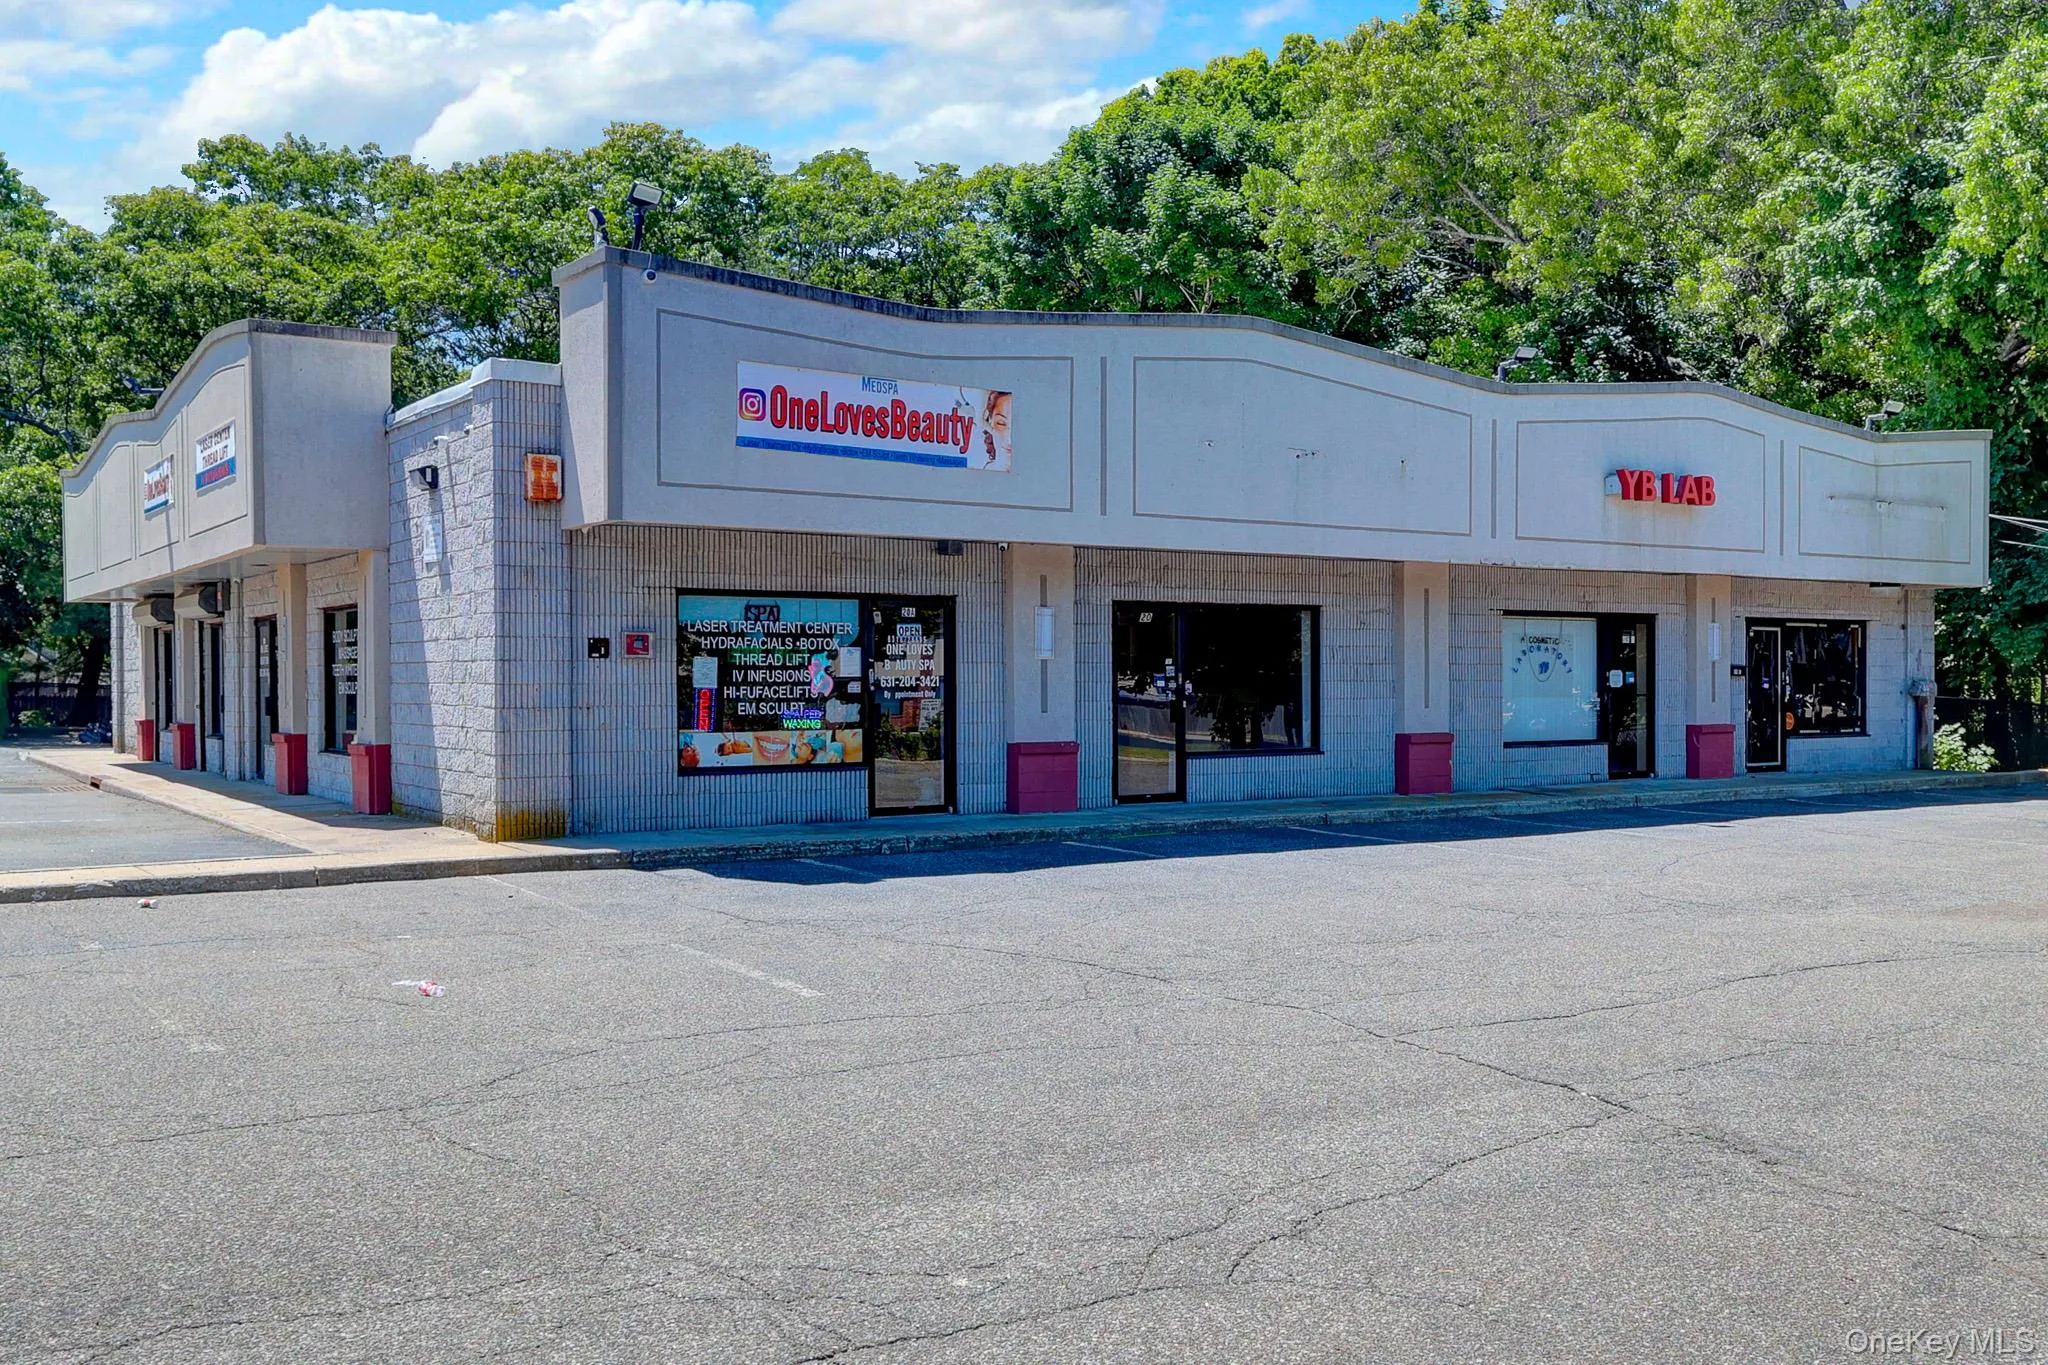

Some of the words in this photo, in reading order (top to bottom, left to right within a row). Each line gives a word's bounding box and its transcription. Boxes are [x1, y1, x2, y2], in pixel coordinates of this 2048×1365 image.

[862, 376, 899, 396] MEDSPA
[770, 384, 975, 454] OneLovesBeauty
[1616, 469, 1657, 501] YB
[1661, 472, 1717, 506] LAB
[746, 605, 779, 621] SPA
[1139, 613, 1152, 622] 20
[687, 620, 728, 633] LASER
[731, 621, 803, 634] TREATMENT
[805, 621, 853, 635] CENTER
[898, 626, 920, 636] OPEN
[701, 636, 793, 650] HYDRAFACIALS
[886, 644, 904, 655] ONE
[906, 643, 933, 655] LOVES
[734, 653, 783, 666] THREAD
[785, 653, 810, 666] LIFT
[918, 659, 936, 671] SPA
[732, 670, 745, 682] IV
[747, 670, 811, 682] INFUSIONS
[880, 676, 940, 687] 631-204-3421
[737, 702, 757, 715] EM
[758, 702, 806, 716] SCULPT
[783, 718, 822, 729] WAXING
